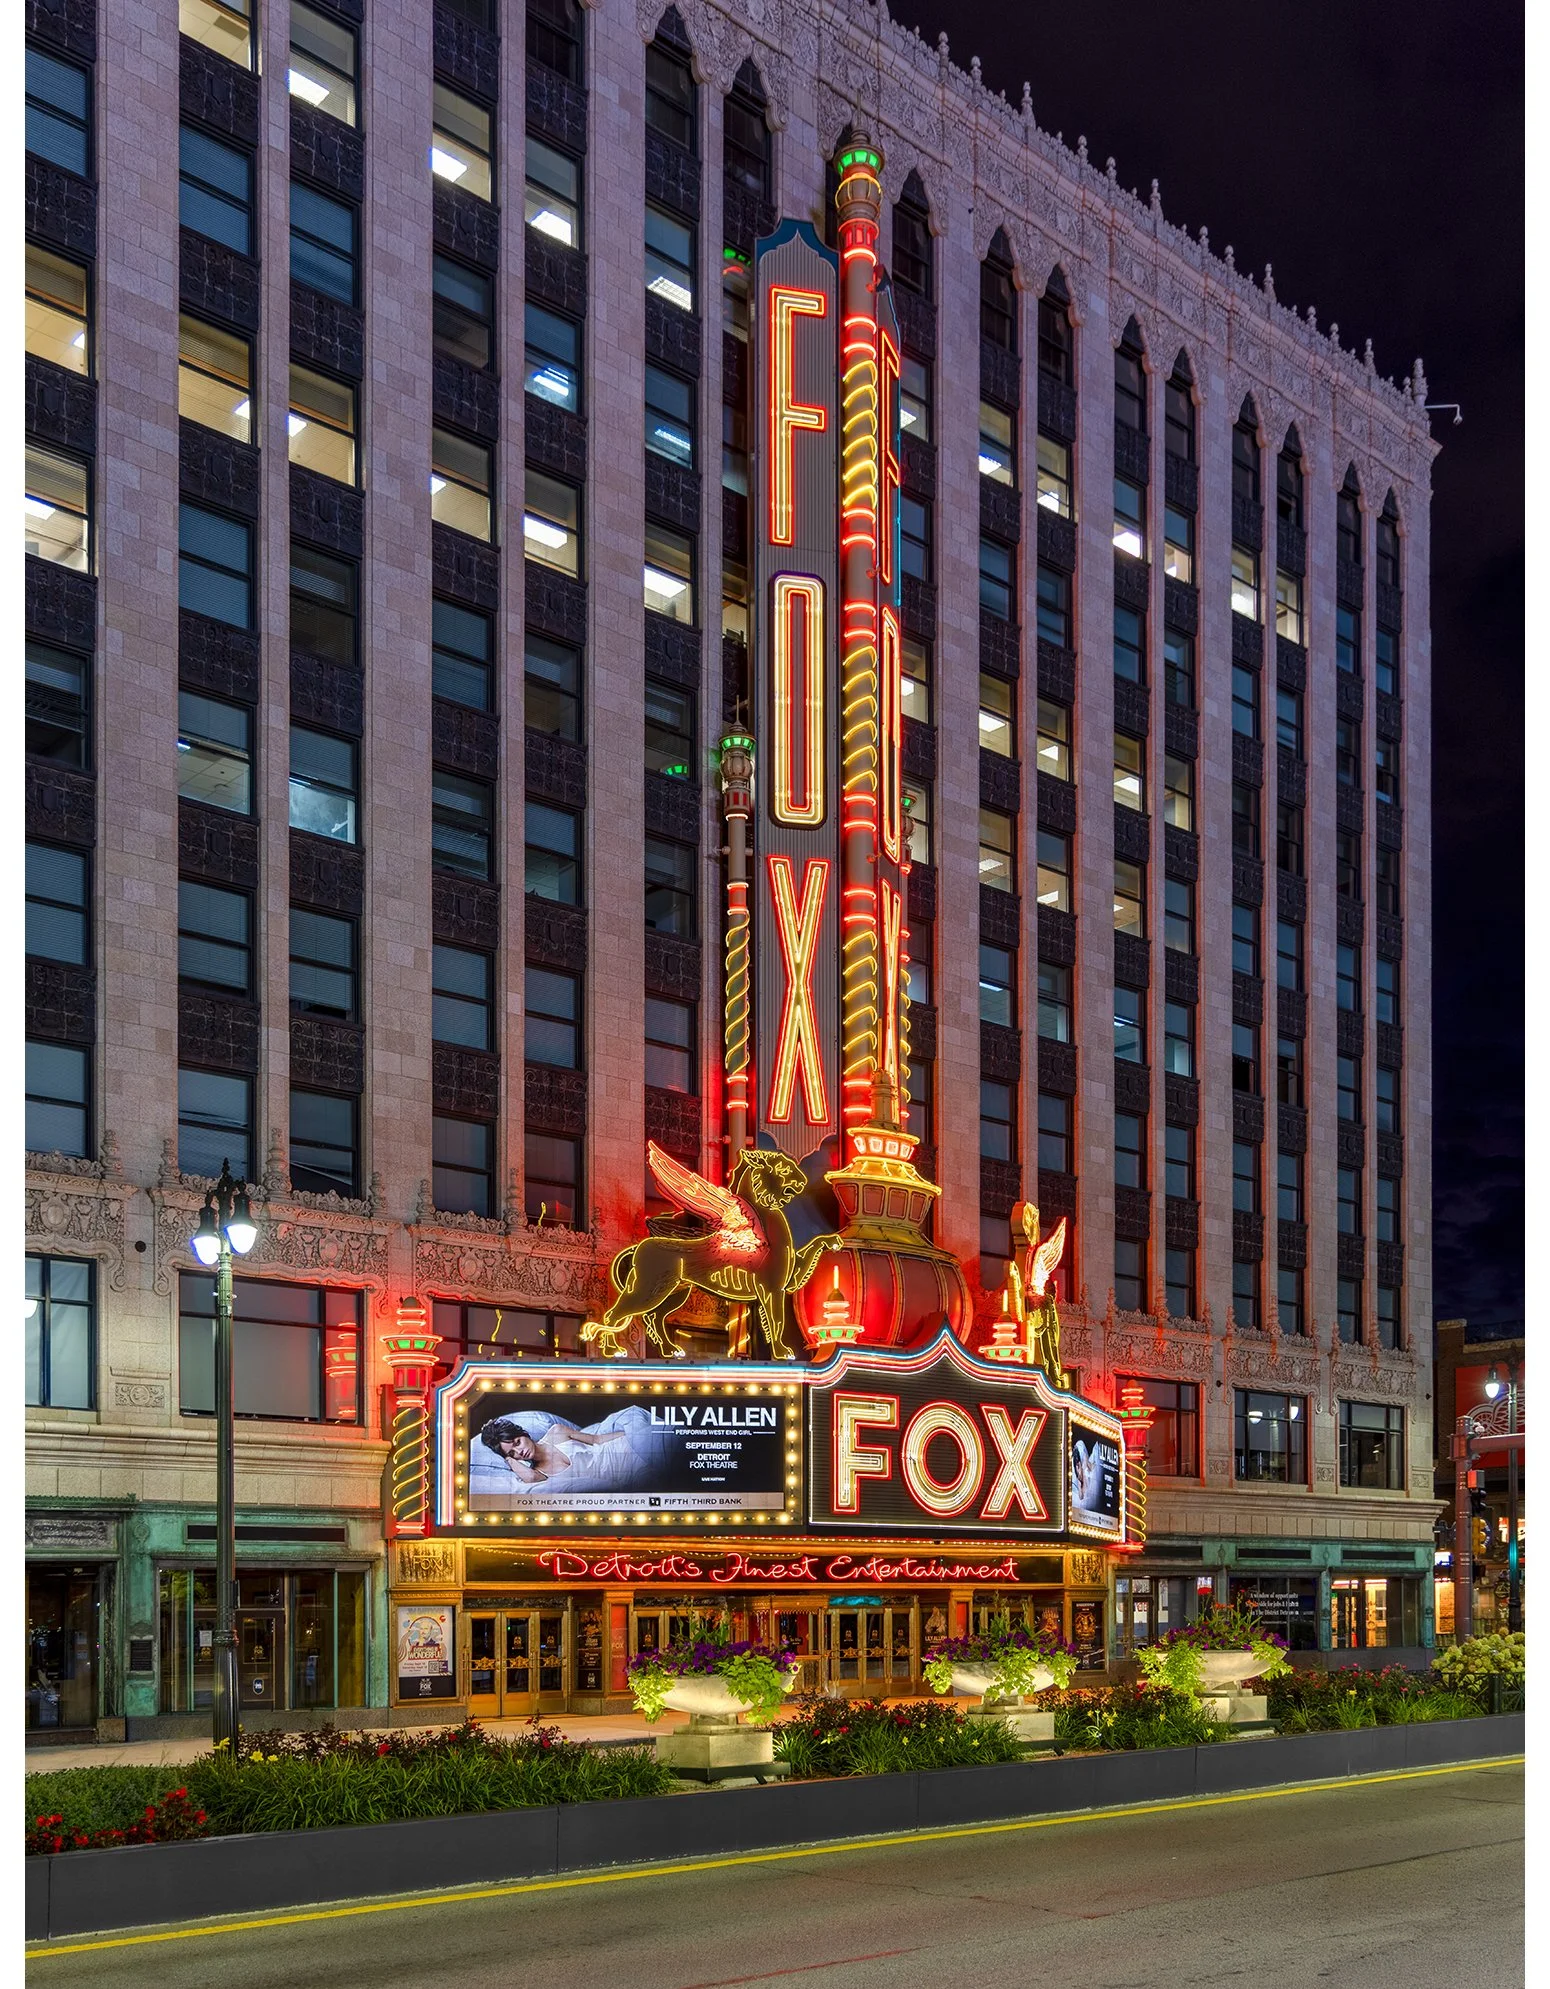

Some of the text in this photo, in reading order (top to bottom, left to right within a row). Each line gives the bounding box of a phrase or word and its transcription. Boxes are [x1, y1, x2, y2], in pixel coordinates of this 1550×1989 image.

[768, 285, 831, 1126] FOX
[650, 1406, 777, 1427] LILY ALLEN
[685, 1442, 742, 1450] SEPTEMBER 12
[697, 1453, 731, 1461] DETROIT
[832, 1390, 1049, 1521] FOX
[689, 1461, 738, 1469] FOX THEATRE
[413, 1555, 442, 1570] FOX
[539, 1551, 1020, 1582] Detroit's Finest Entertainment
